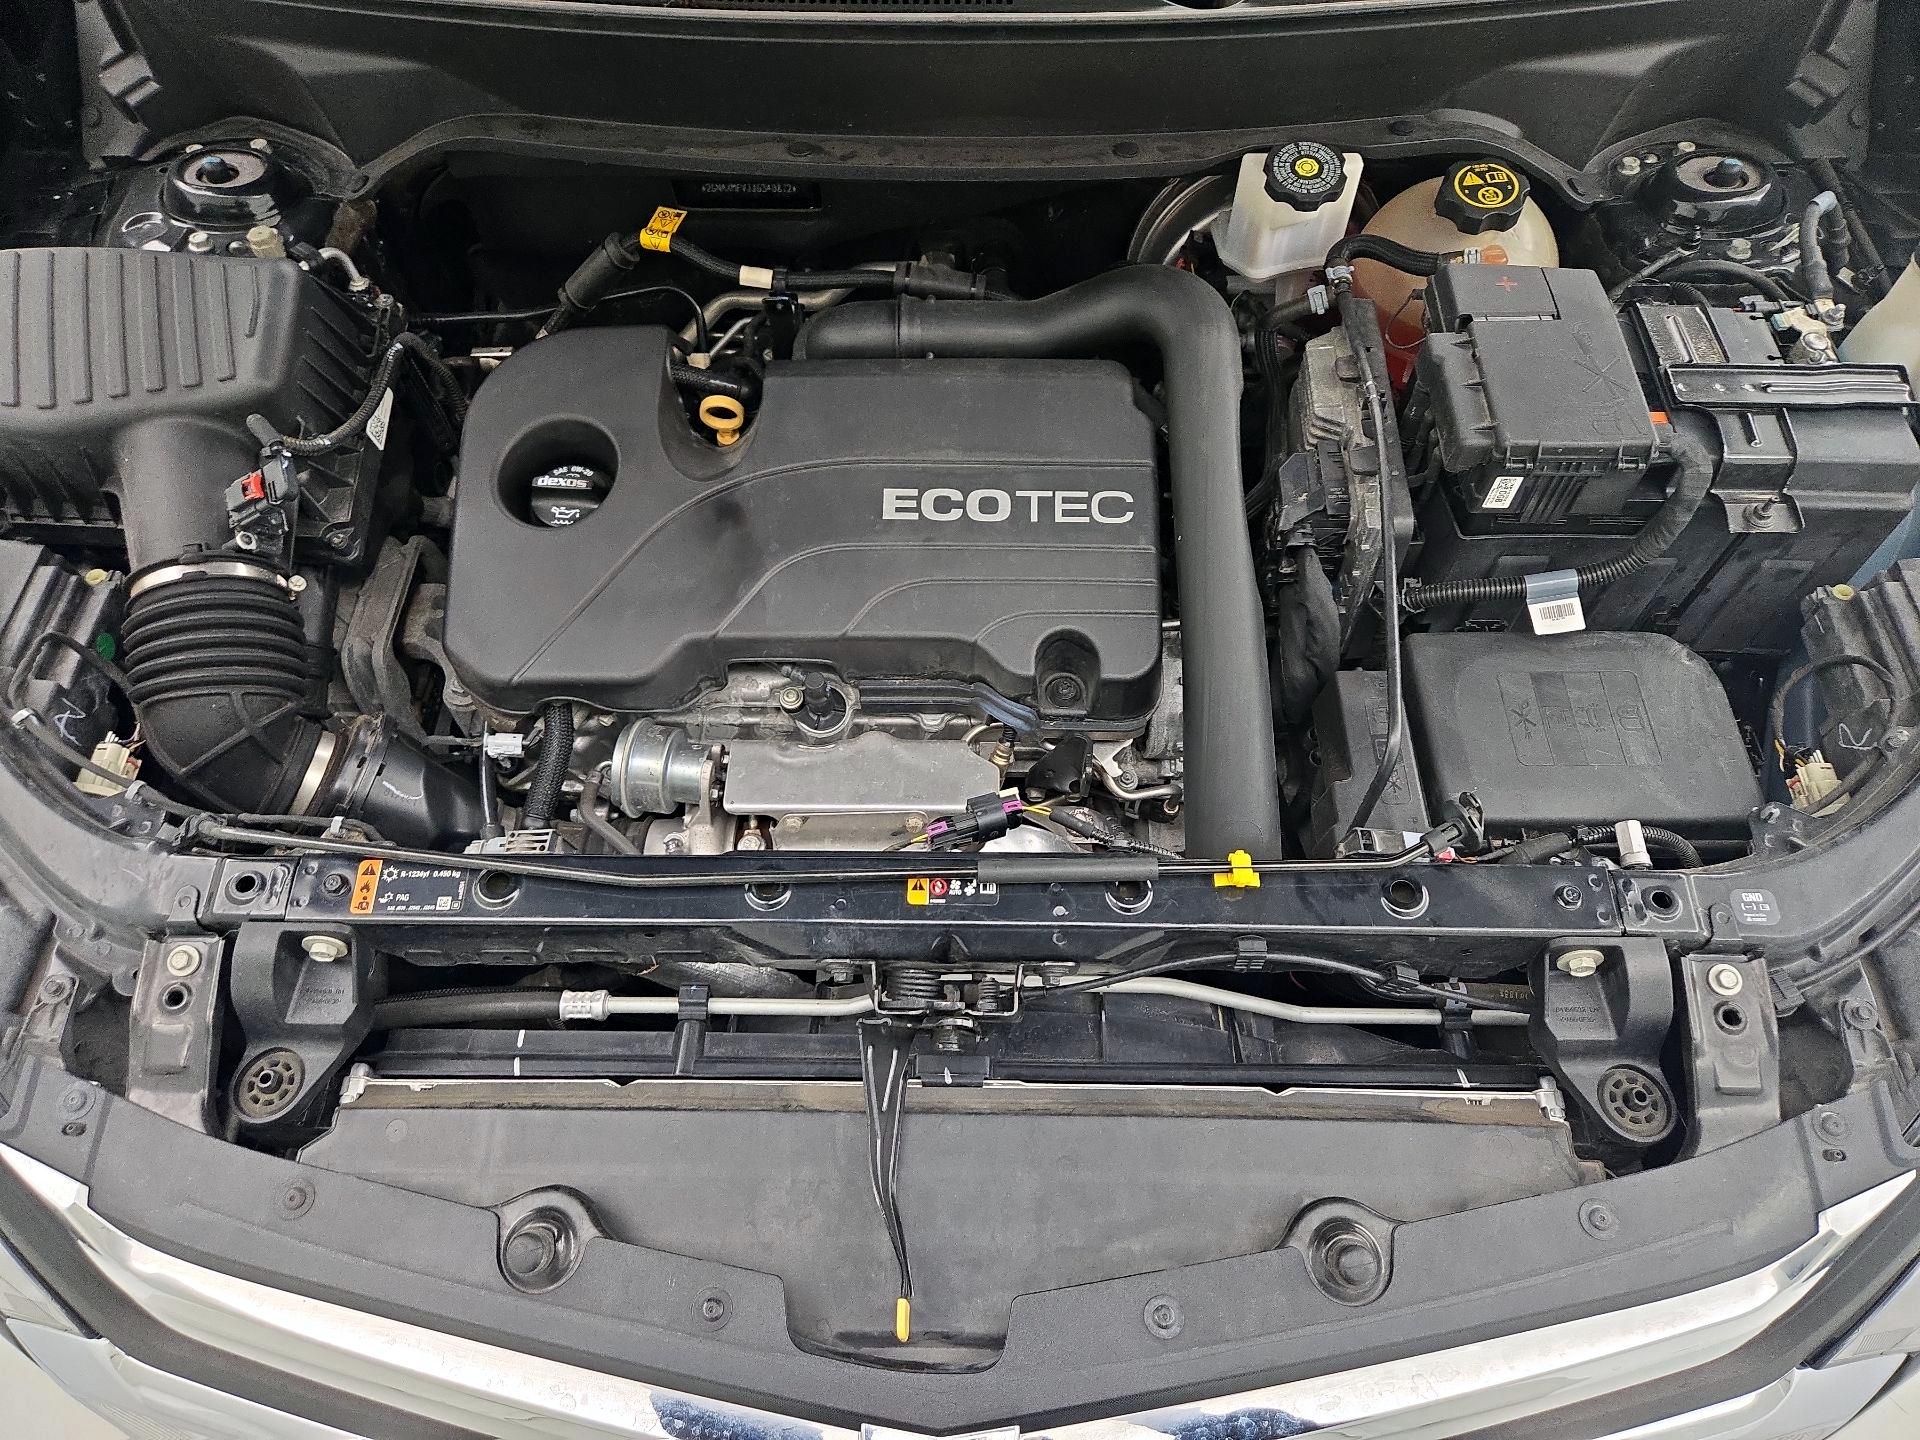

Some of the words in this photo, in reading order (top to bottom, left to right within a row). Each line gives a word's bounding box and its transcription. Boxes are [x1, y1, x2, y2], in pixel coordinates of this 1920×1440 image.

[553, 466, 568, 476] SAE
[537, 475, 589, 488] dexos
[882, 488, 1134, 524] ECOTEC
[452, 870, 461, 879] kg
[396, 894, 410, 902] PAG
[1741, 892, 1763, 902] GND
